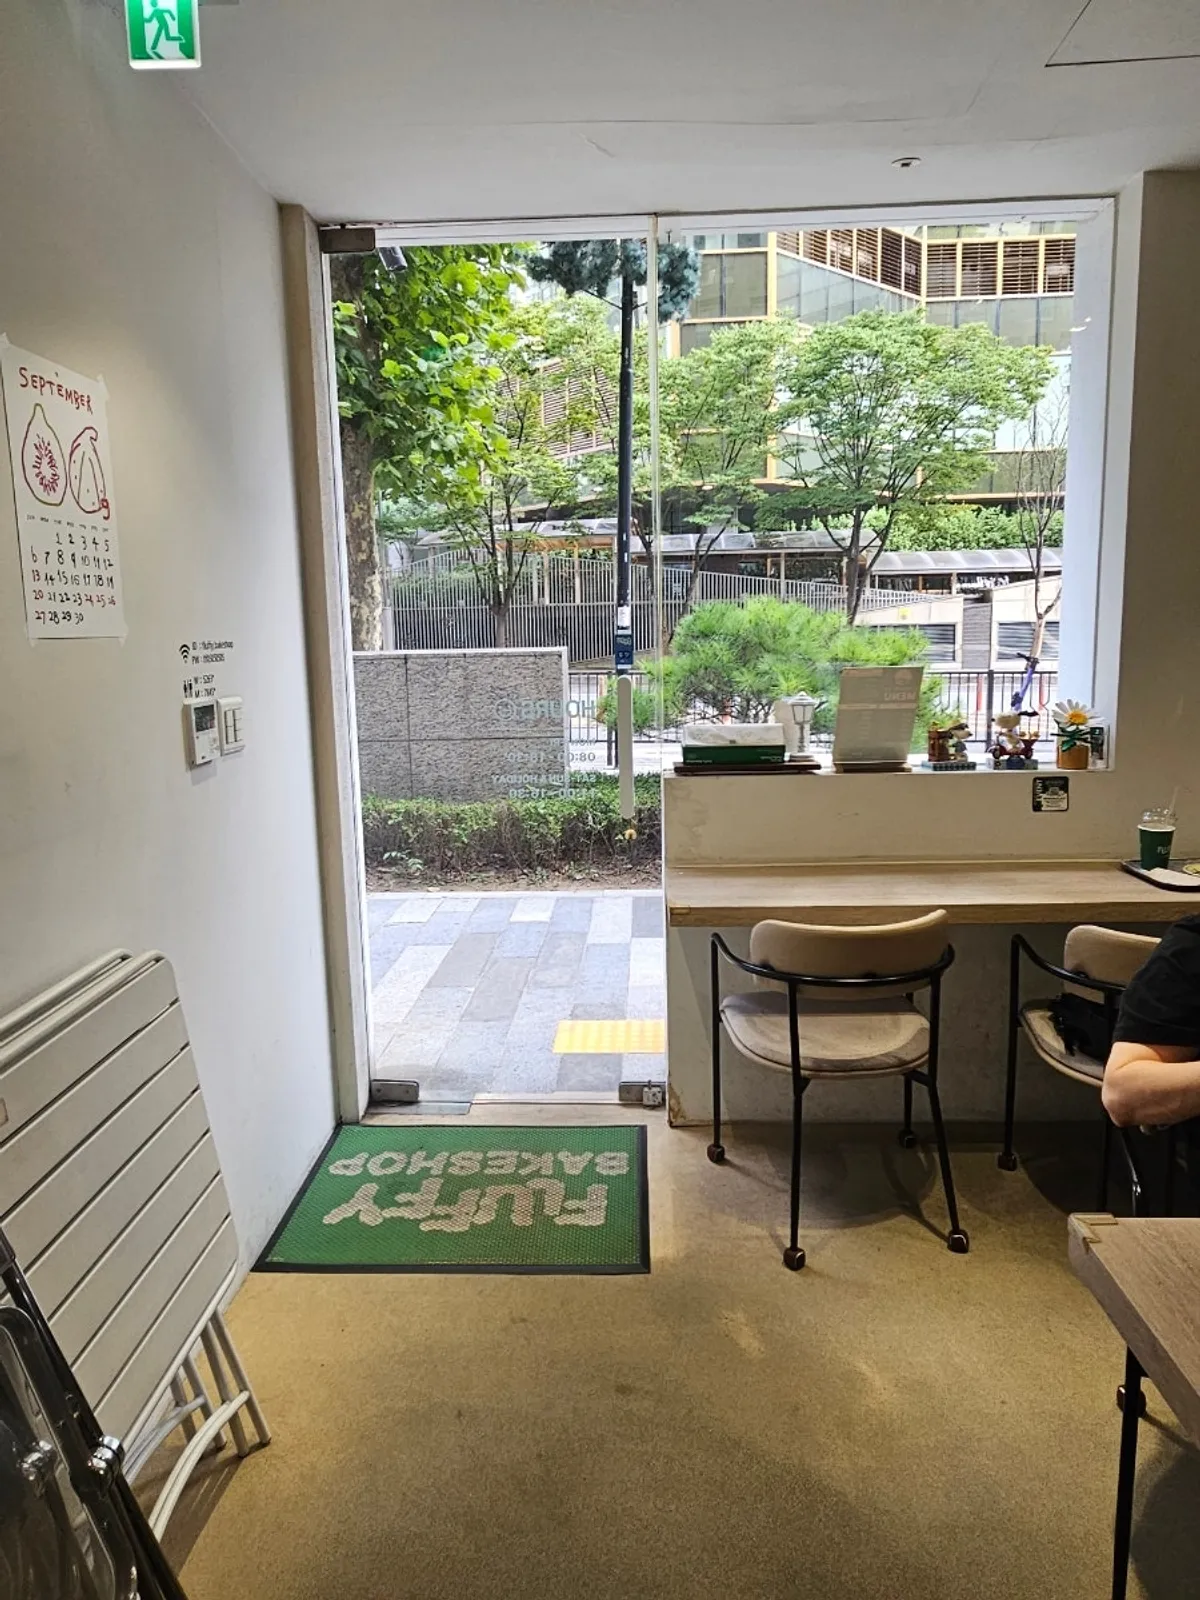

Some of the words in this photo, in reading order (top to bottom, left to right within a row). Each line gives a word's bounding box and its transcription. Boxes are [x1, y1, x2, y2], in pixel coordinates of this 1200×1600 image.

[18, 366, 93, 415] SEPTEMBER
[55, 532, 62, 545] 1
[68, 533, 75, 545] 2
[81, 535, 87, 550] 3
[92, 537, 99, 552] 4
[104, 539, 110, 552] 5
[31, 545, 38, 563] 6
[44, 551, 50, 565] 7
[57, 550, 64, 565] 8
[70, 552, 76, 569] 9
[81, 555, 90, 567] 10
[93, 556, 100, 569] 11
[103, 558, 114, 570] 12
[32, 569, 40, 582] 13
[44, 572, 55, 586] 14
[57, 569, 68, 585] 15
[70, 574, 80, 586] 16
[94, 574, 104, 587] 18
[32, 589, 44, 600] 20
[48, 592, 56, 602] 21
[58, 592, 70, 603] 22
[72, 592, 82, 606] 23
[84, 594, 94, 607] 24
[96, 594, 106, 608] 25
[35, 610, 46, 625] 27
[48, 610, 60, 625] 28
[62, 610, 72, 622] 29
[74, 612, 84, 625] 30
[328, 1150, 630, 1176] BAKESHOP
[322, 1177, 608, 1232] FLUFFY
